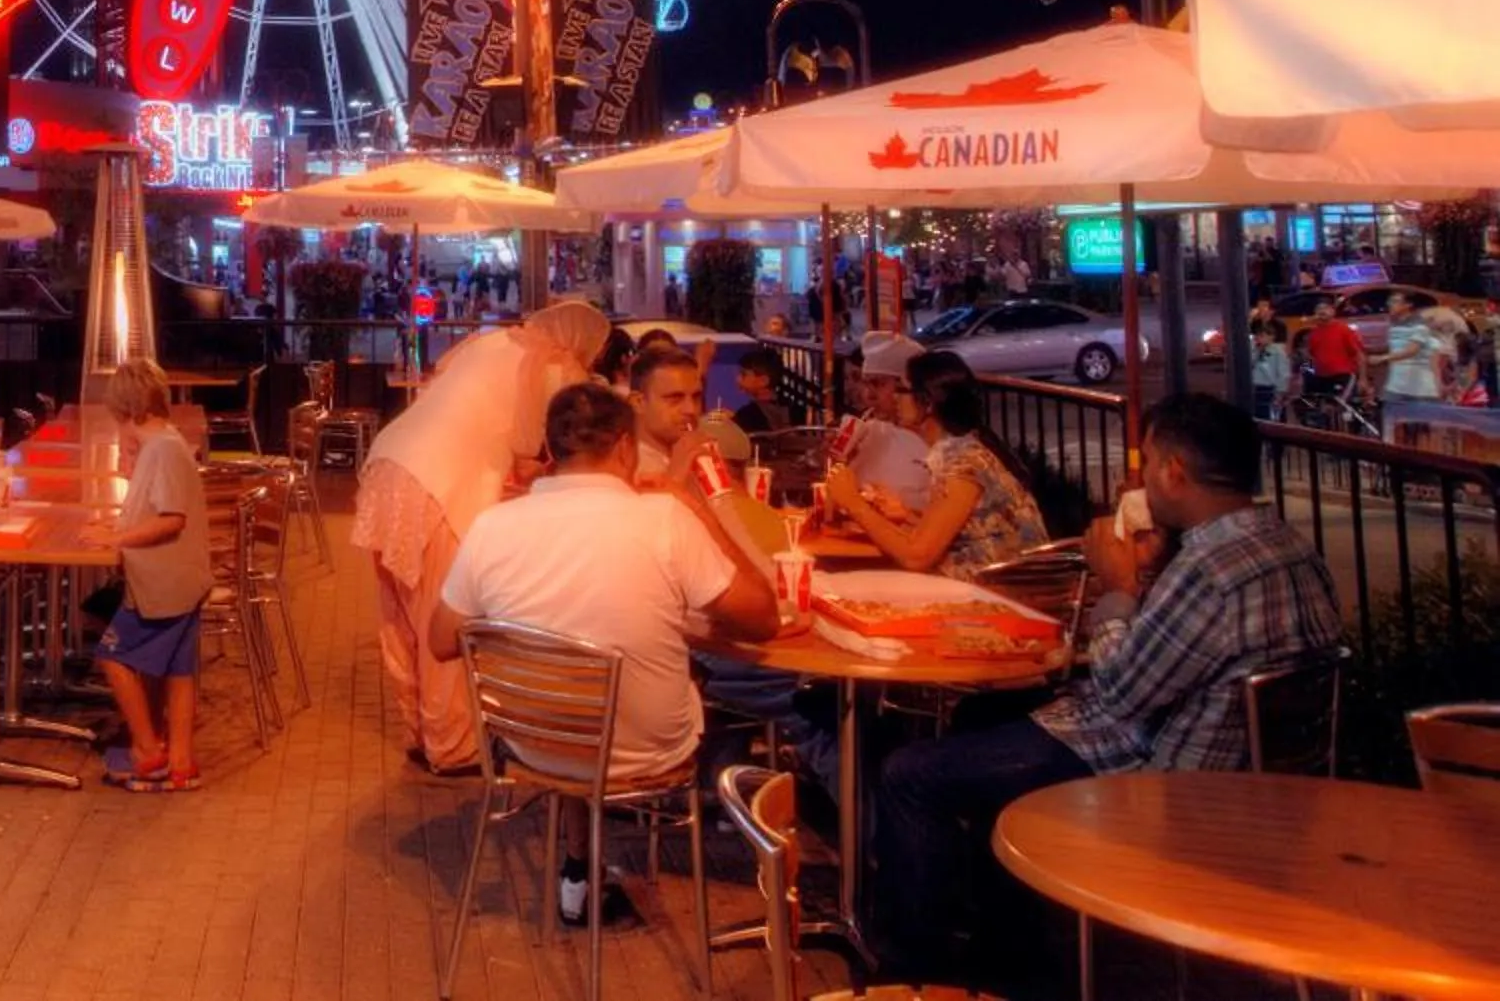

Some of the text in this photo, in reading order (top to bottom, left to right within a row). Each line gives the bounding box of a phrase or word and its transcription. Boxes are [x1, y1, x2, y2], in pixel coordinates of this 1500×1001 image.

[410, 9, 450, 64] LIVE
[556, 6, 593, 61] LIVE
[918, 129, 1060, 169] CANADIAN
